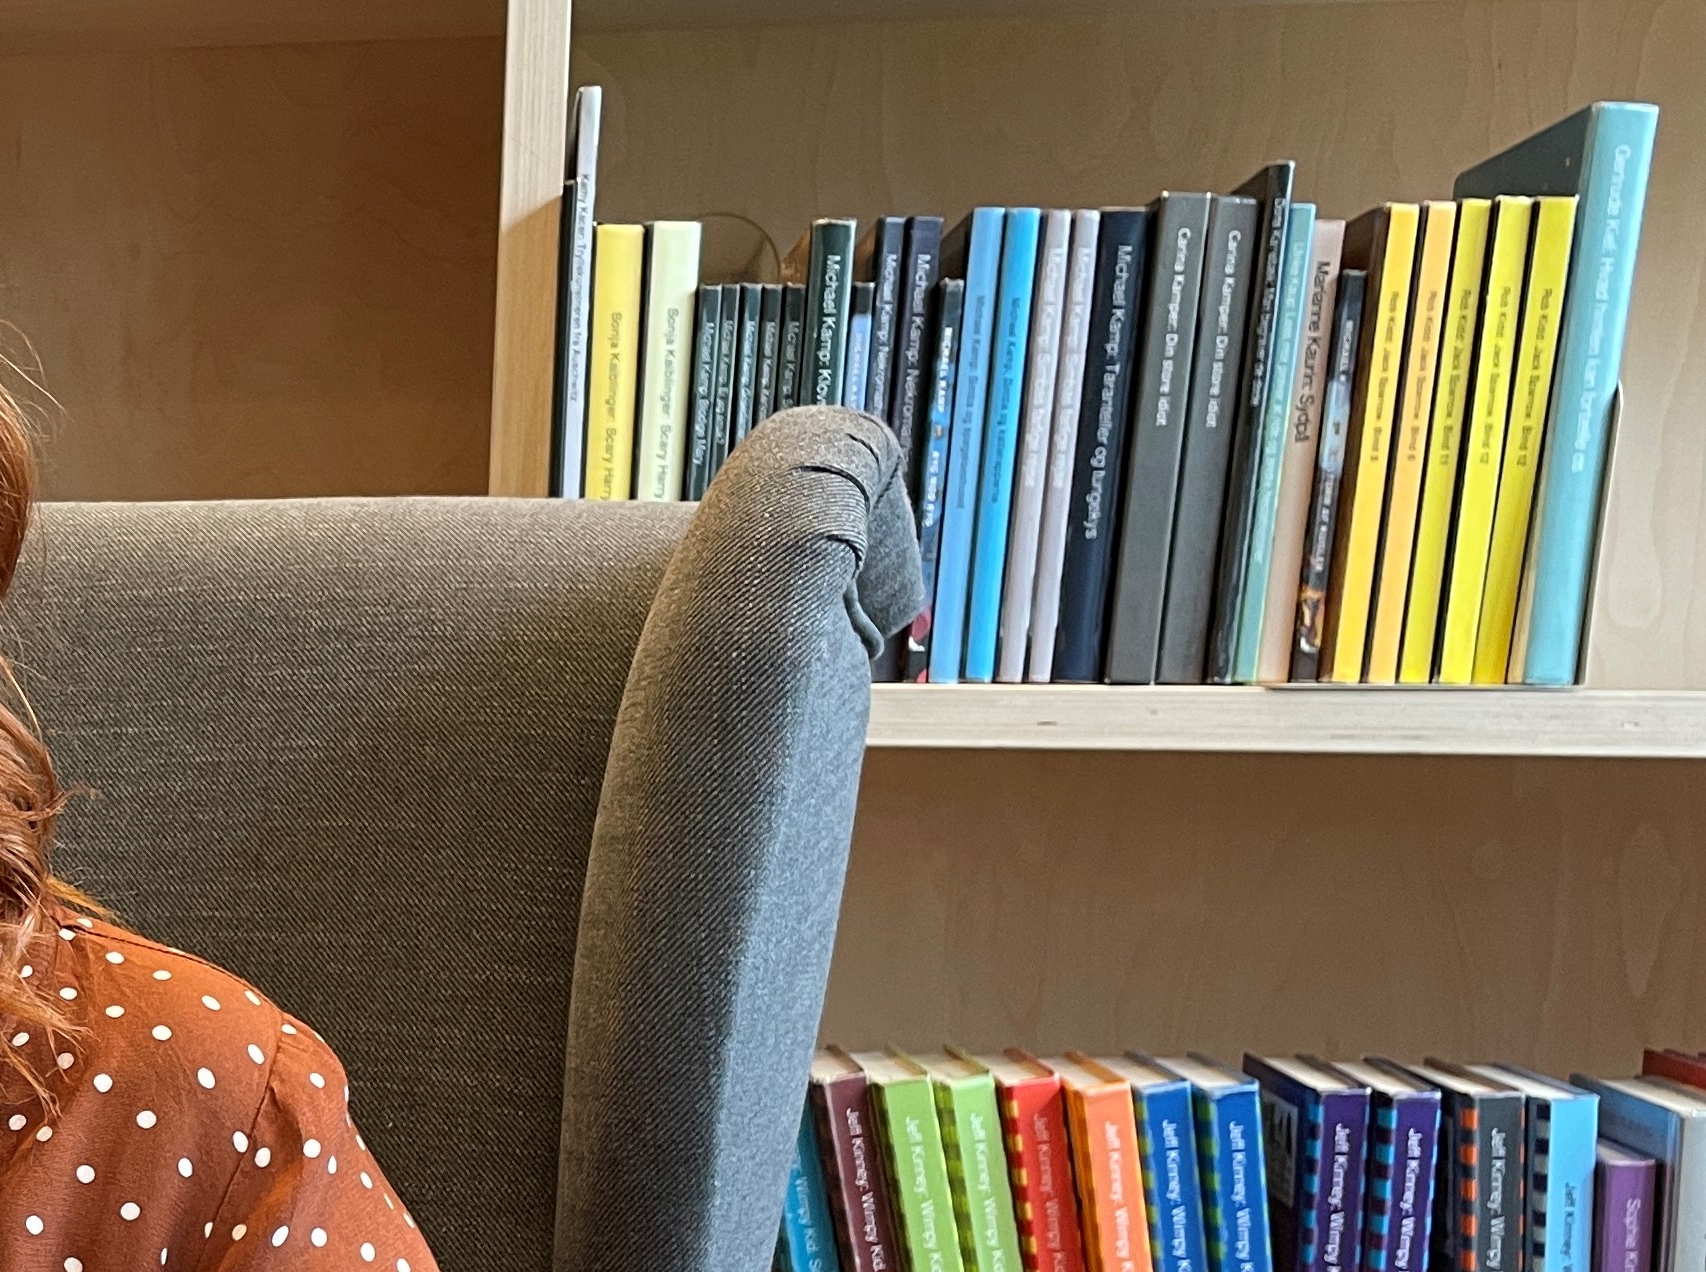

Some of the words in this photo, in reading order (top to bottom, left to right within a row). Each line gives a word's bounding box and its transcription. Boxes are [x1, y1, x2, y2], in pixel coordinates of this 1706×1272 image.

[1112, 245, 1133, 306] Michael
[1224, 230, 1242, 274] Carina
[822, 254, 841, 313] Michael
[1308, 261, 1331, 332] Marianne
[817, 316, 836, 366] Kamp:
[1105, 309, 1126, 360] Kamp:
[1215, 335, 1228, 359] Din
[1090, 447, 1108, 467] og
[846, 1108, 862, 1135] Jeff
[1162, 1119, 1179, 1148] Jeff
[1228, 1121, 1246, 1150] Jeff
[1334, 1123, 1352, 1153] Jeff
[1407, 1128, 1422, 1157] Jeff
[1490, 1128, 1506, 1156] Jeff
[852, 1137, 870, 1191] Kinney:
[970, 1113, 986, 1140] Jeff
[984, 1196, 1000, 1247] Wimpy
[1105, 1121, 1121, 1150] Jeff
[1115, 1206, 1130, 1259] Wimpy
[1165, 1149, 1182, 1205] Kinney:
[1231, 1151, 1247, 1208] Kinney:
[1328, 1154, 1350, 1211] Kinney:
[1399, 1159, 1420, 1215] Kinney:
[862, 1191, 879, 1243] Wimpy
[1172, 1205, 1187, 1258] Wimpy
[1235, 1208, 1251, 1260] Wimpy
[1324, 1211, 1346, 1264] Wimpy
[1394, 1216, 1415, 1269] Wimpy
[1486, 1215, 1505, 1269] Wimpy
[871, 1244, 886, 1272] Kid.
